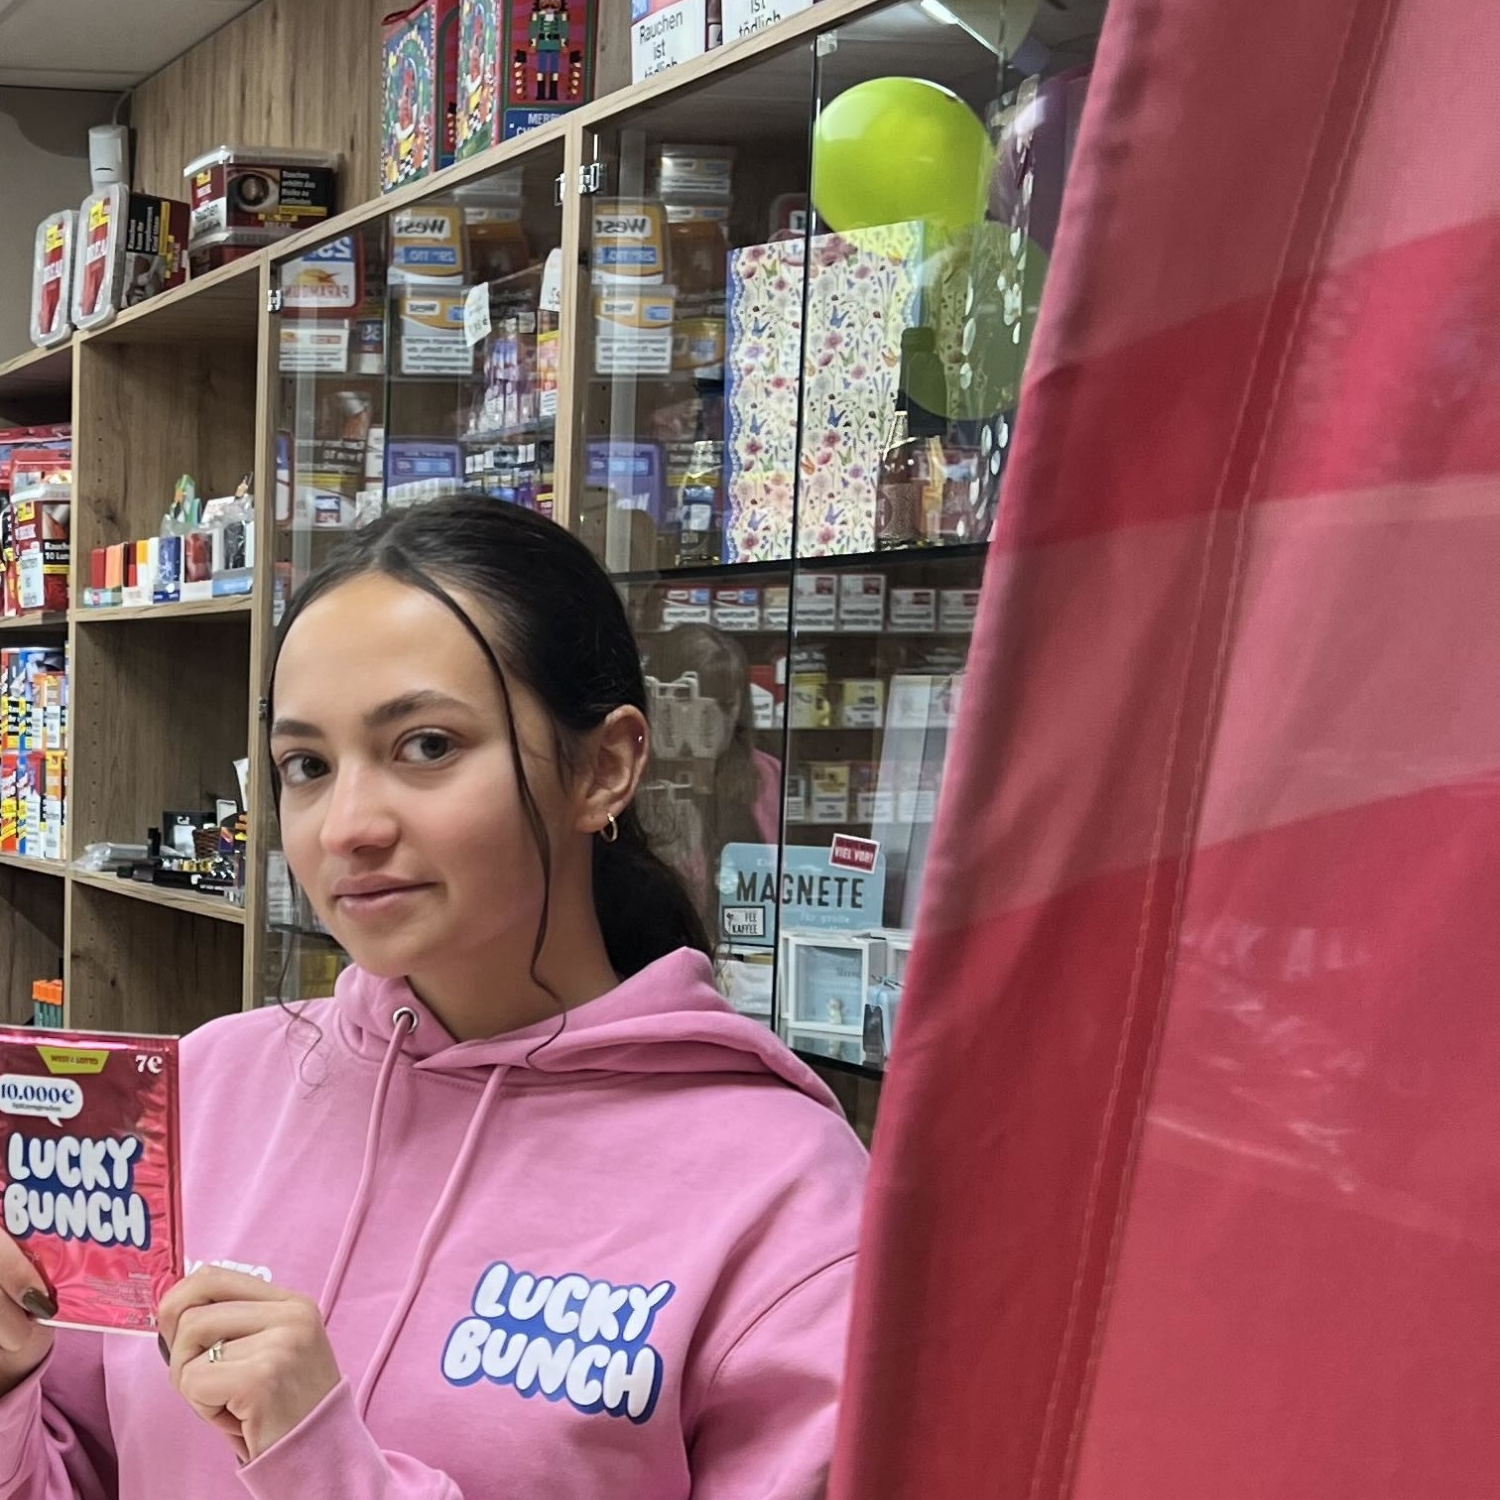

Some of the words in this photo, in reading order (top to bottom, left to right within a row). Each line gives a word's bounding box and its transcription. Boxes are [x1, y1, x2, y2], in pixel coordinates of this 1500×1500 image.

[640, 11, 683, 45] Rauchen
[653, 41, 665, 56] ist
[736, 871, 864, 908] MAGNETE
[135, 1054, 163, 1075] 7€
[1, 1082, 75, 1104] 10.000€
[8, 1132, 138, 1191] LUCKY
[4, 1183, 146, 1247] BUNCH
[474, 1263, 671, 1342] LUCKY
[443, 1318, 656, 1418] BUNCH
